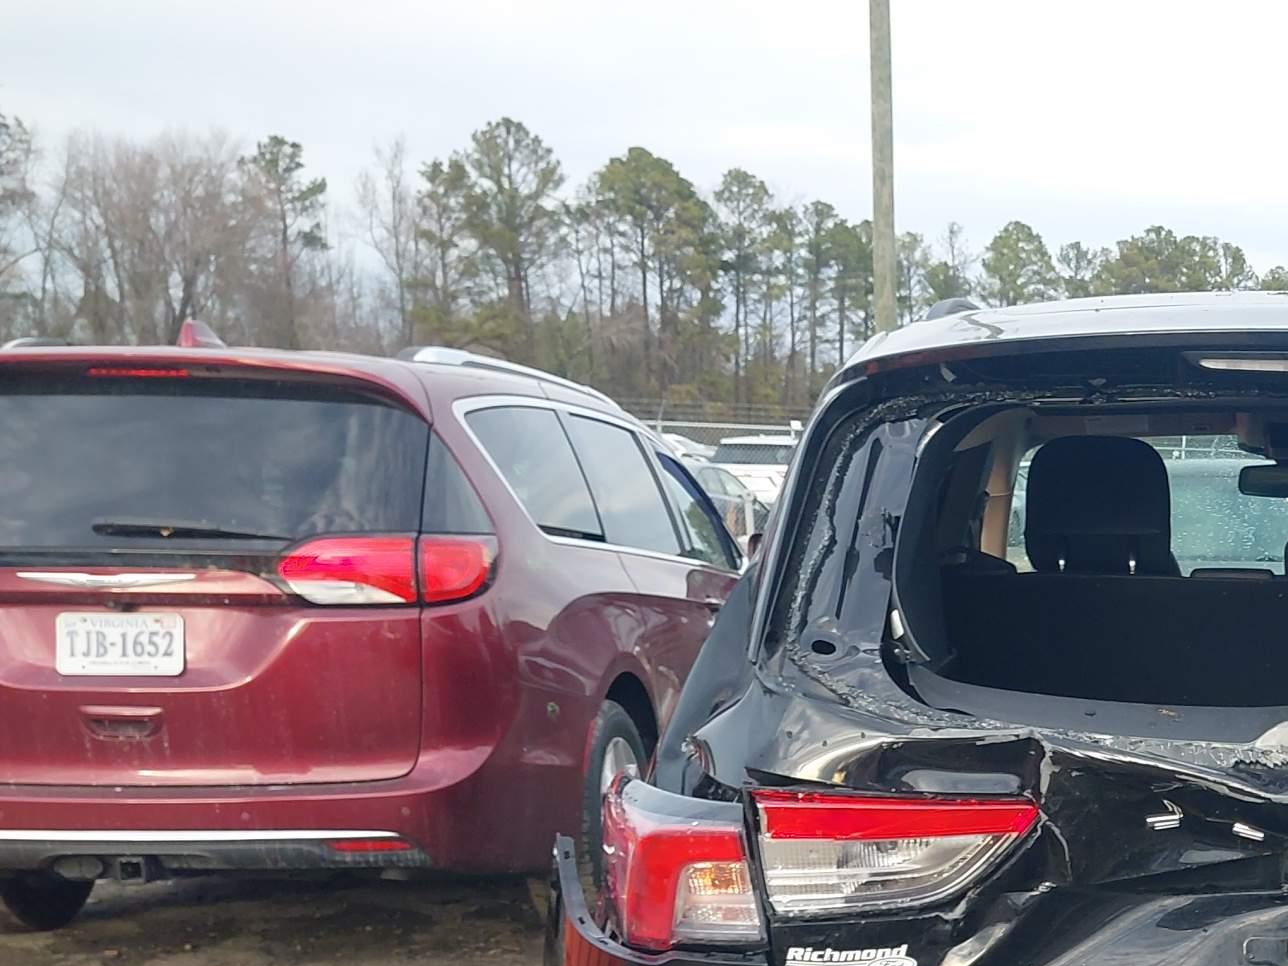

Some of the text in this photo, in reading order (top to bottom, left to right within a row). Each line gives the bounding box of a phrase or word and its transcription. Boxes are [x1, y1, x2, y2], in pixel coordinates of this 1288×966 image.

[90, 616, 149, 629] VIRGINIA
[66, 631, 174, 658] TJB-1652
[786, 944, 908, 962] Richmond
